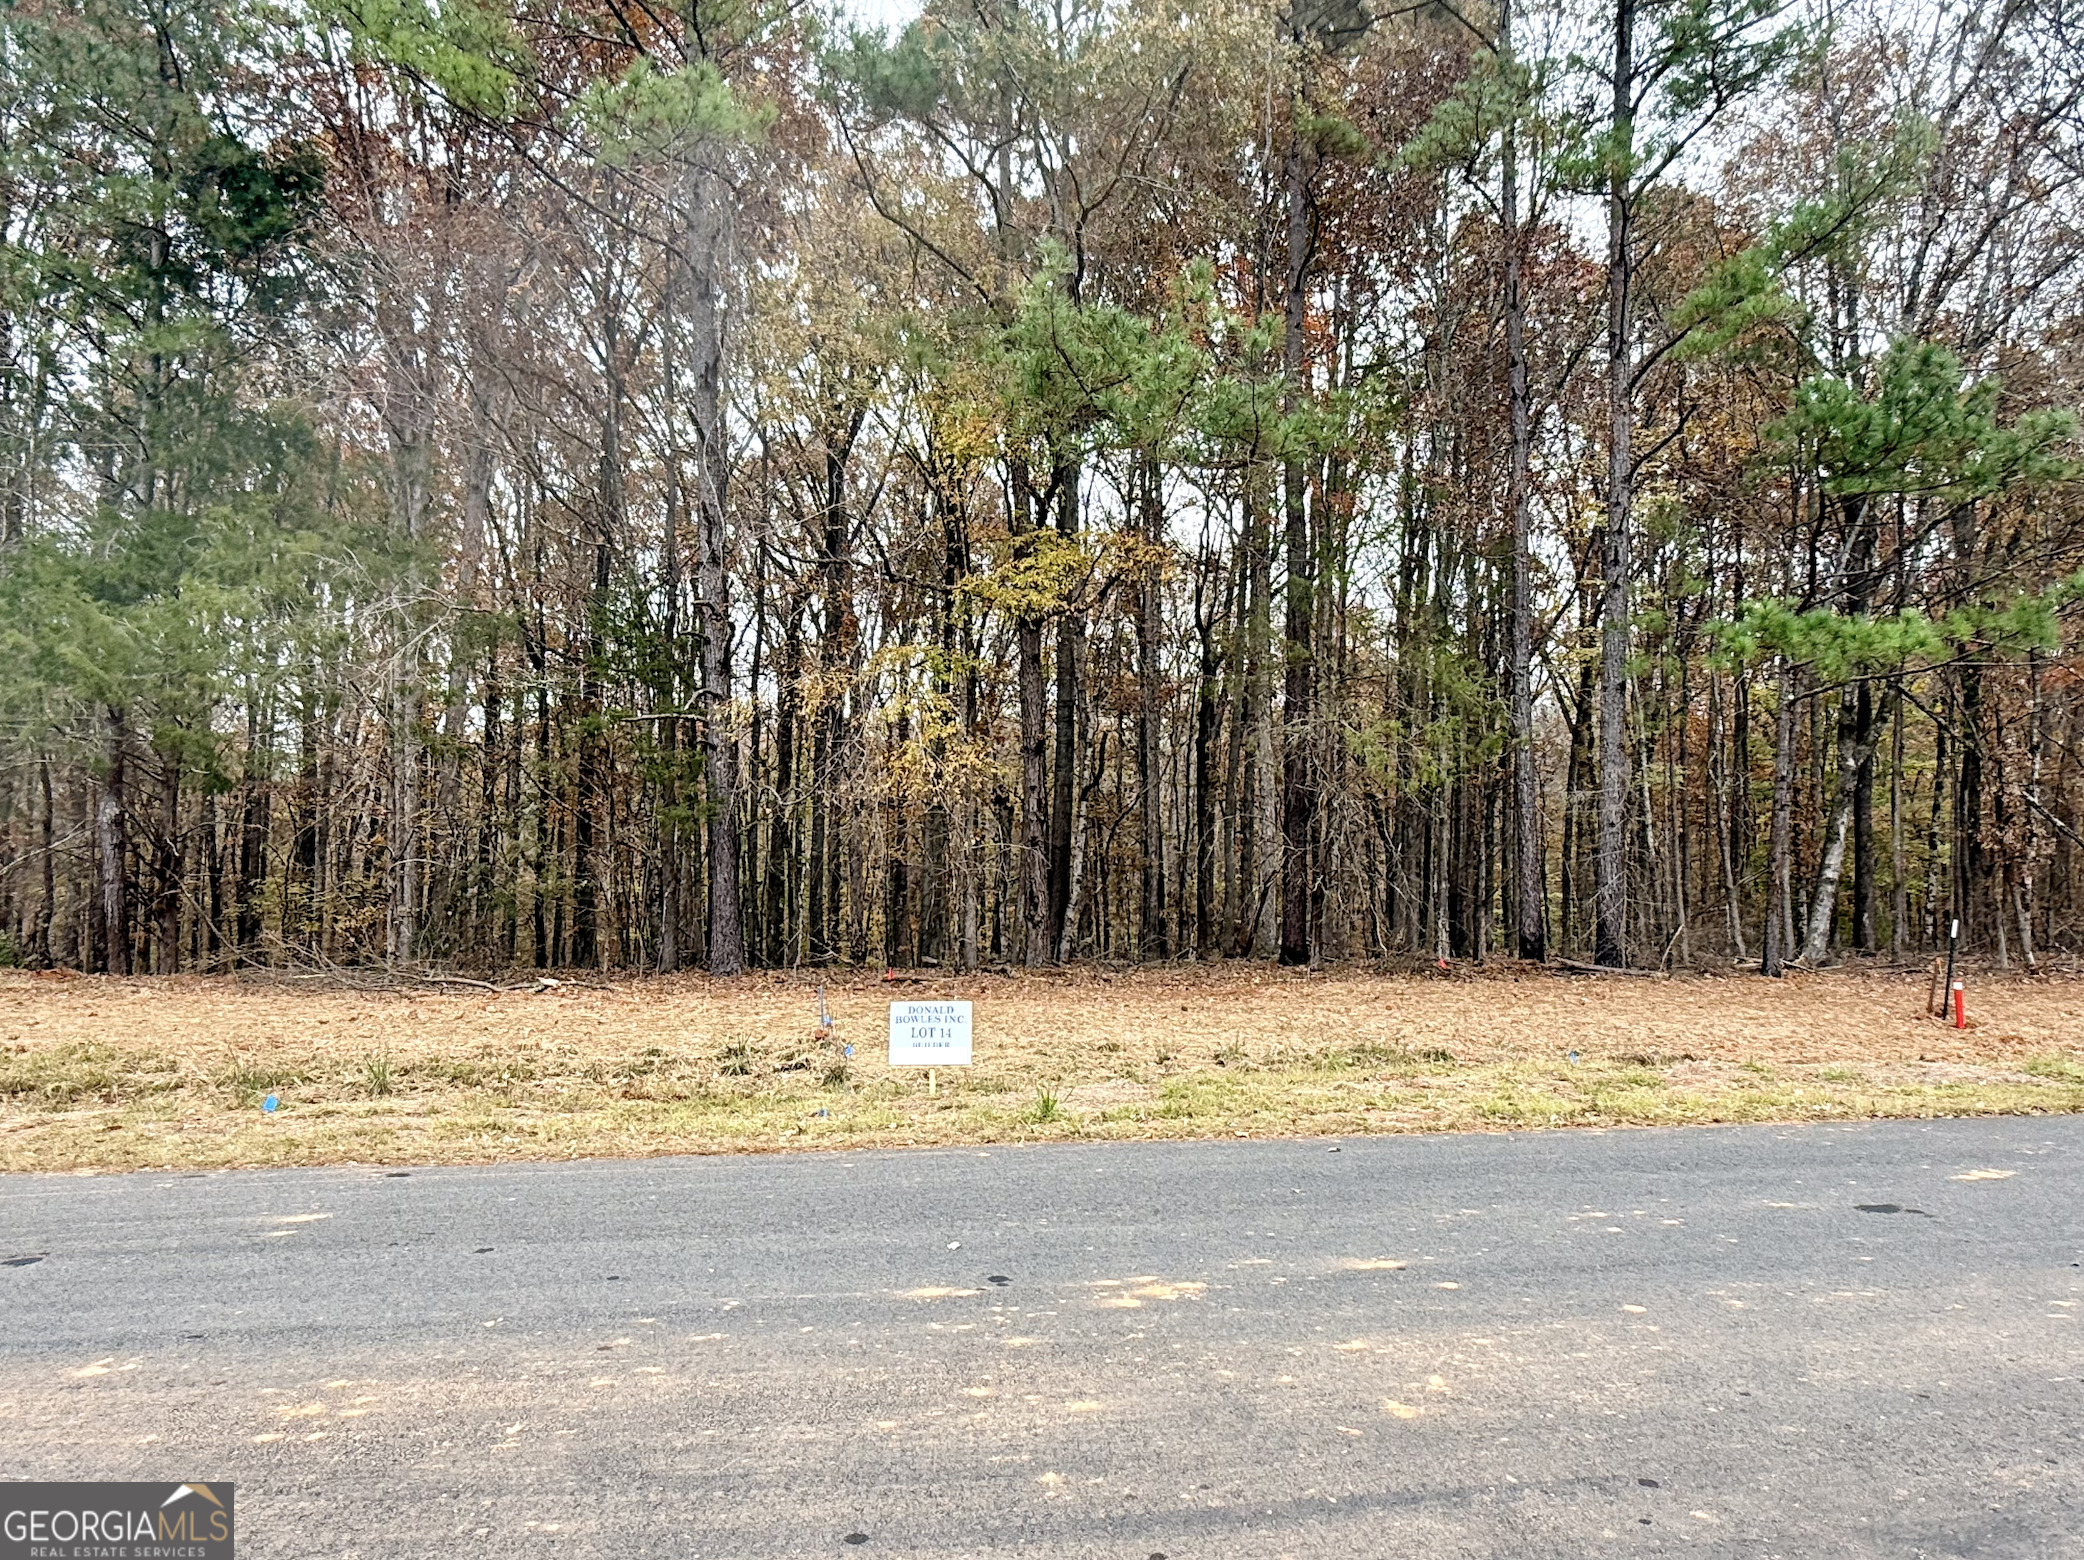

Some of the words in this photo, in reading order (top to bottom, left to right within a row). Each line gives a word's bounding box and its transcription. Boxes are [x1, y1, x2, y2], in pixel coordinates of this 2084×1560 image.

[908, 1006, 954, 1014] DONALD
[895, 1015, 941, 1024] BOWLES
[911, 1027, 936, 1038] LOT
[941, 1028, 951, 1038] 14
